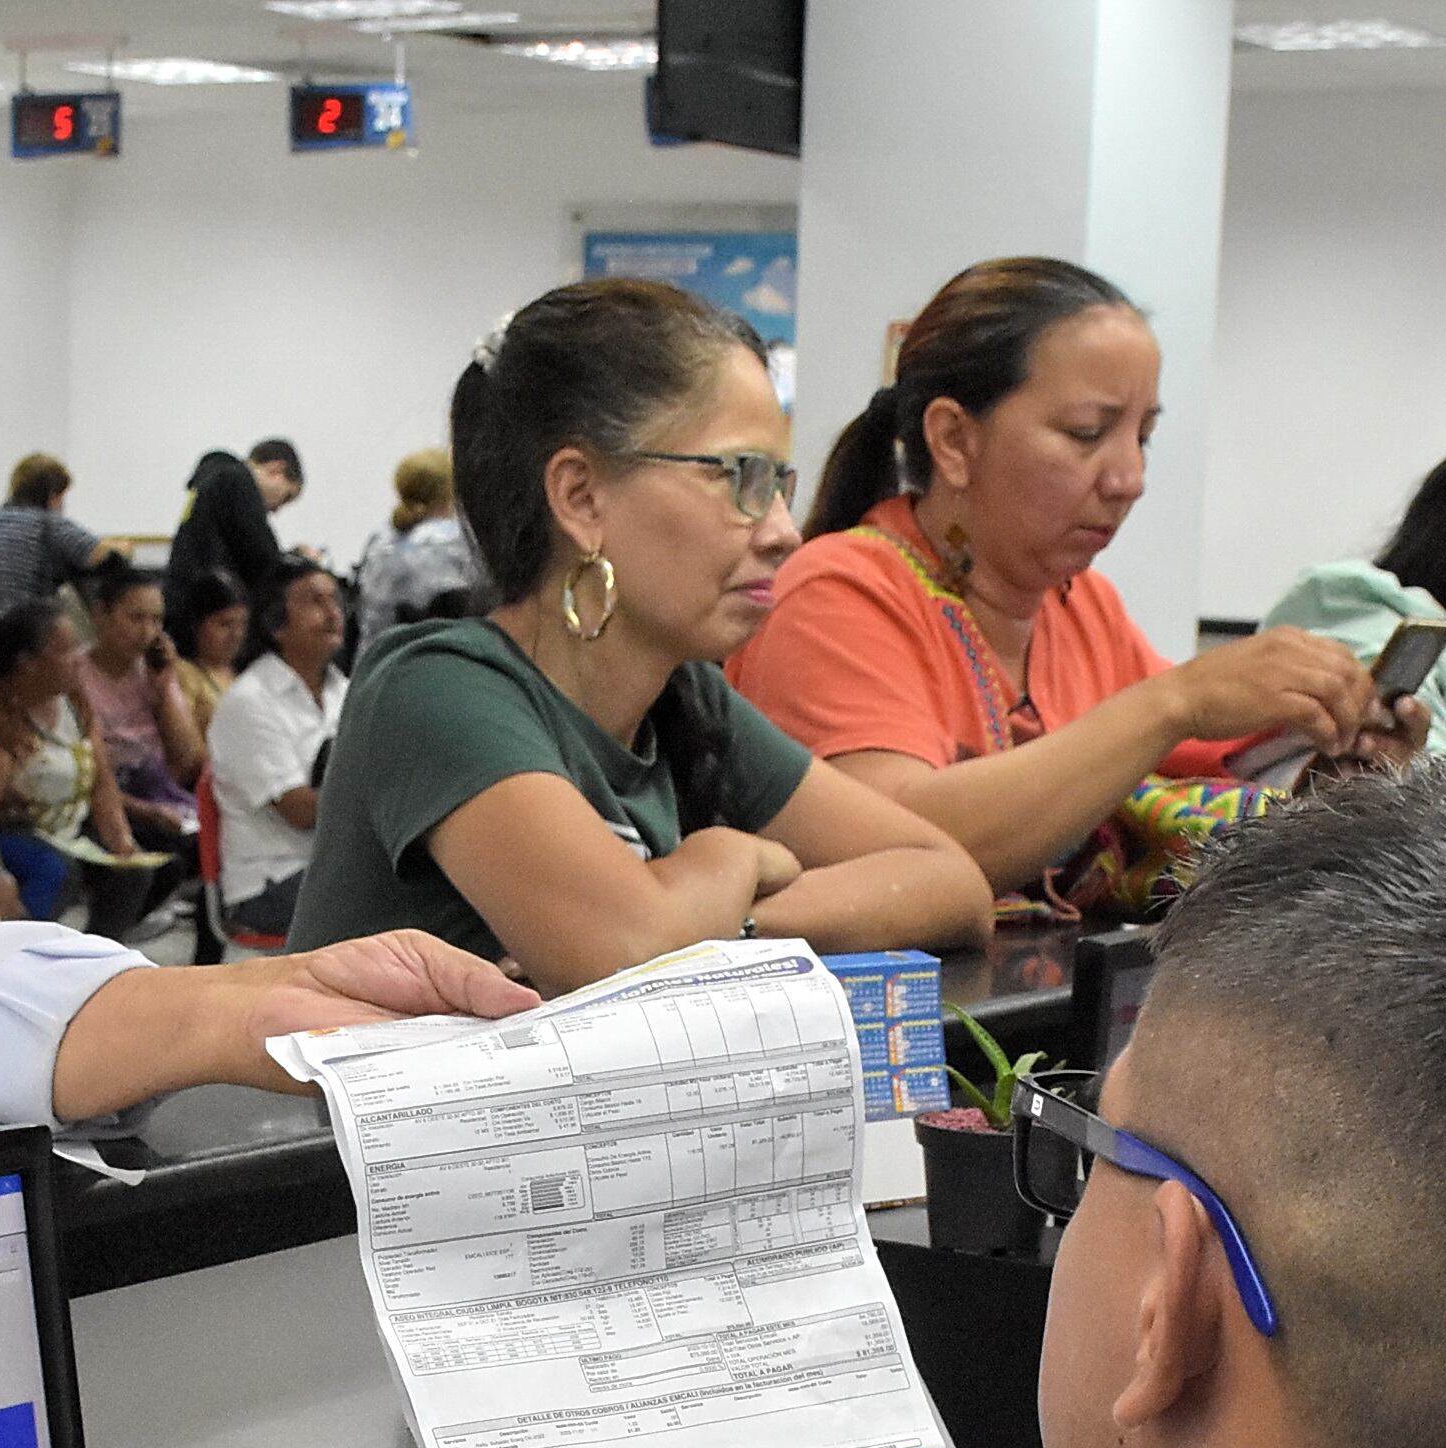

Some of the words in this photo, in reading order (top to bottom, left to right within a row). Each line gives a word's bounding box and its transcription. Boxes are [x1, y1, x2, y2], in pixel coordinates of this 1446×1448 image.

[318, 99, 342, 134] 2
[360, 1107, 433, 1124] ALCANTARILLADO
[456, 1306, 486, 1316] CIUDAD
[487, 1302, 512, 1311] LIMPIA
[517, 1414, 552, 1425] DETALLE
[553, 1411, 564, 1419] DE
[565, 1408, 591, 1418] OTROS
[592, 1404, 625, 1415] COBROS
[631, 1397, 668, 1410] ALIANZAS
[669, 1392, 699, 1404] EMCALI
